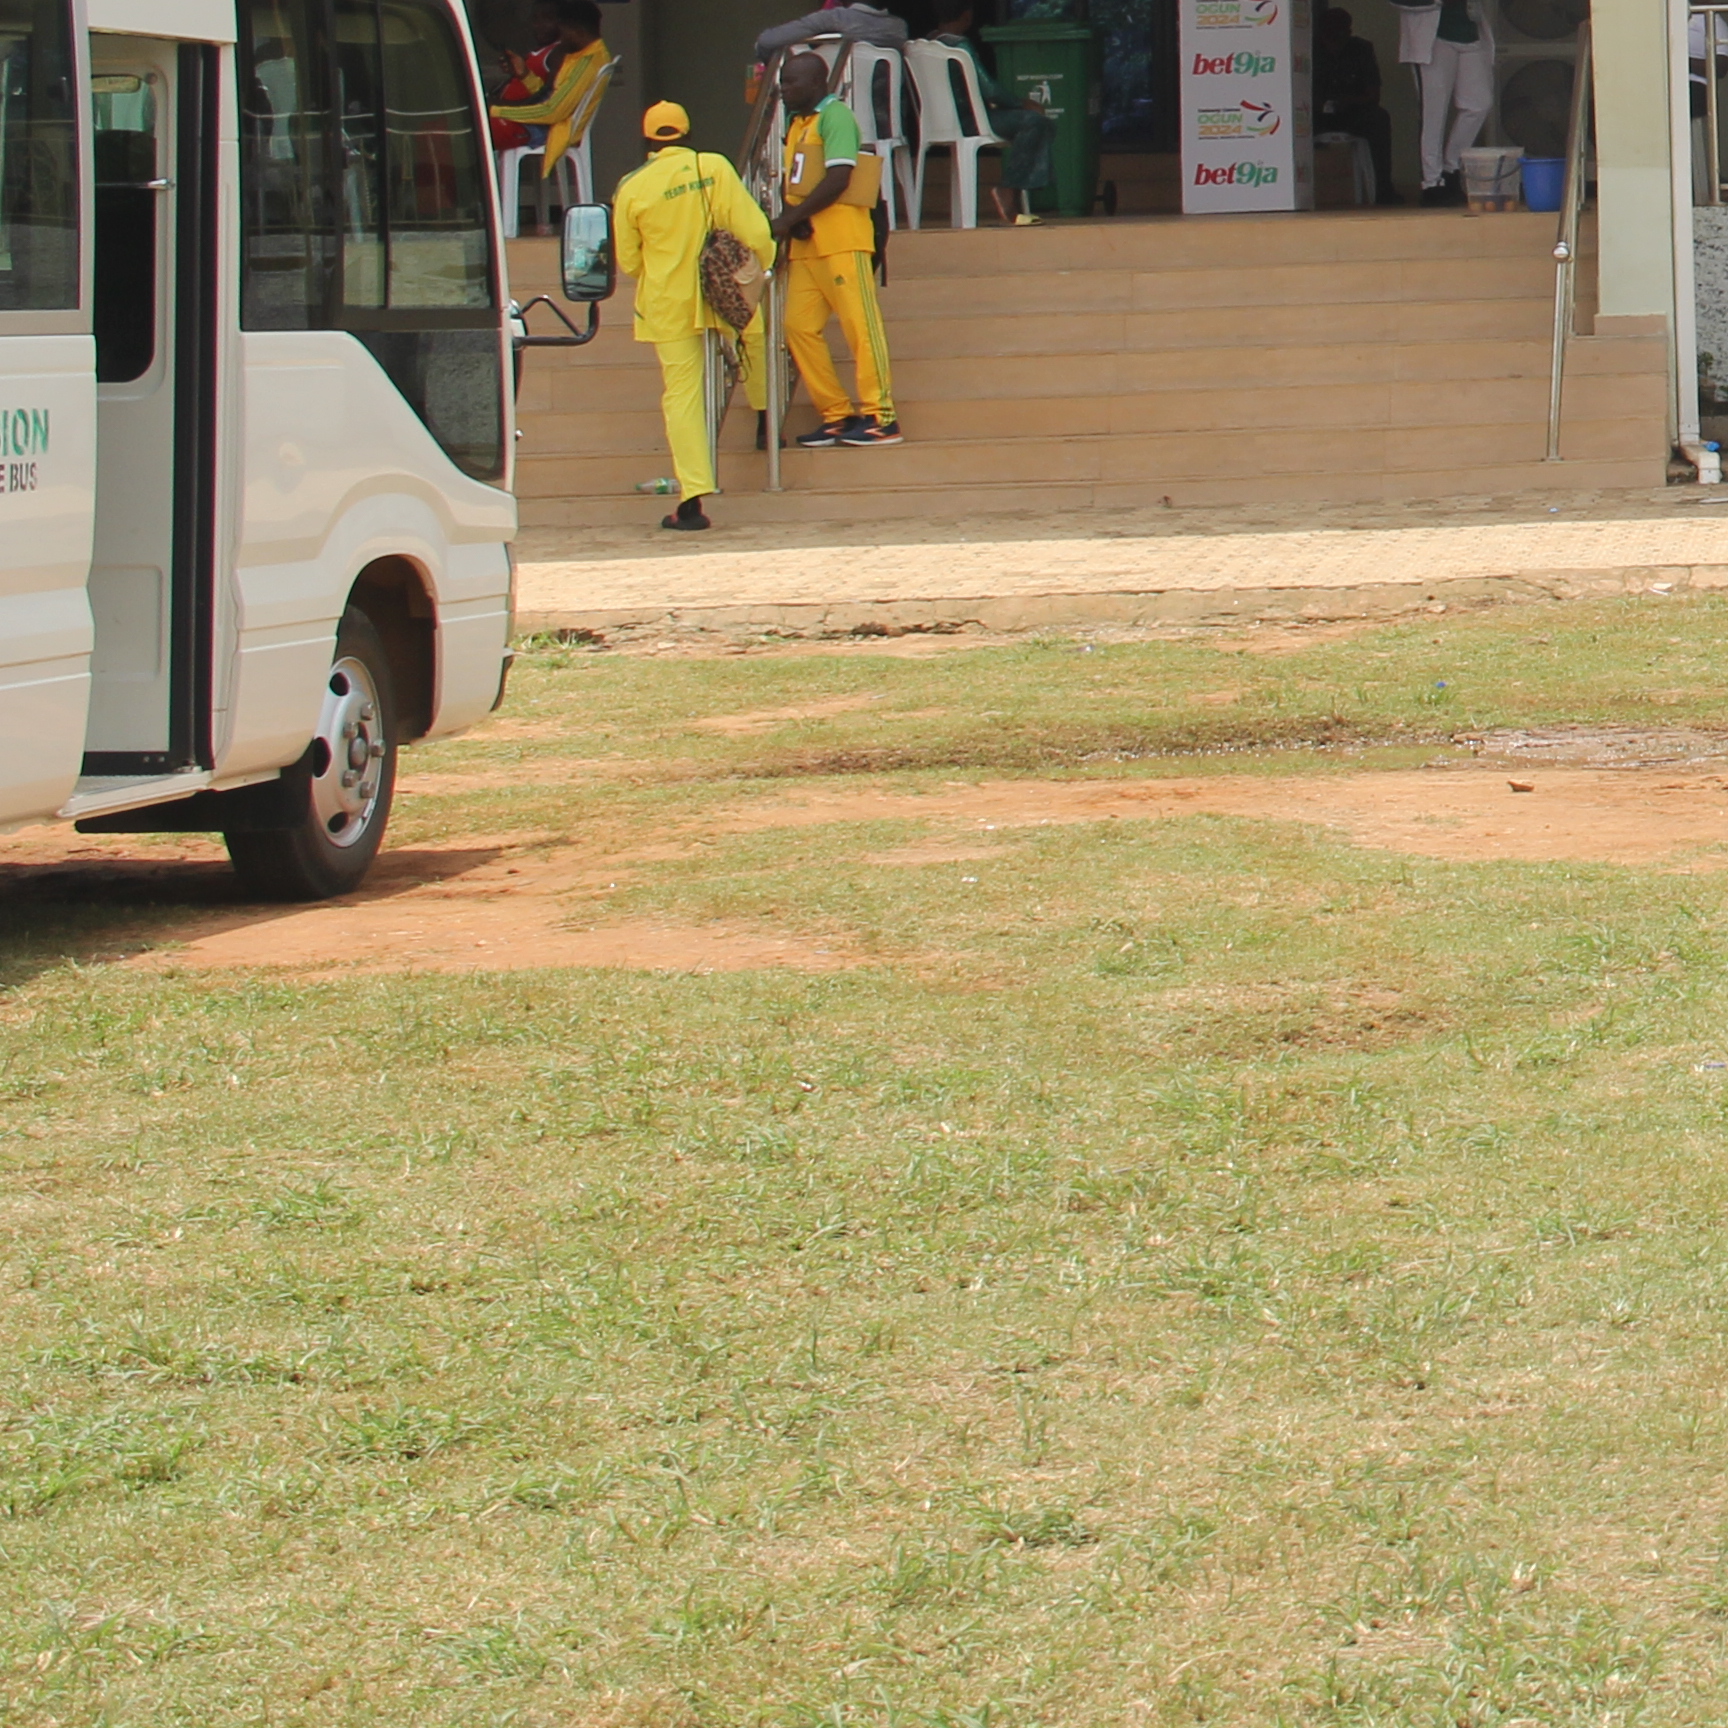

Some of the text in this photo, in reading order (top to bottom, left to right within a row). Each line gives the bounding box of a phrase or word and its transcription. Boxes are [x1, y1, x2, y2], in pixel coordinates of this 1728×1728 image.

[1196, 15, 1240, 26] 2024
[1192, 51, 1276, 78] bet9ja
[1198, 125, 1242, 135] 2024
[1194, 161, 1279, 188] bet9ja
[0, 408, 49, 456] ION
[9, 462, 38, 492] BUS
